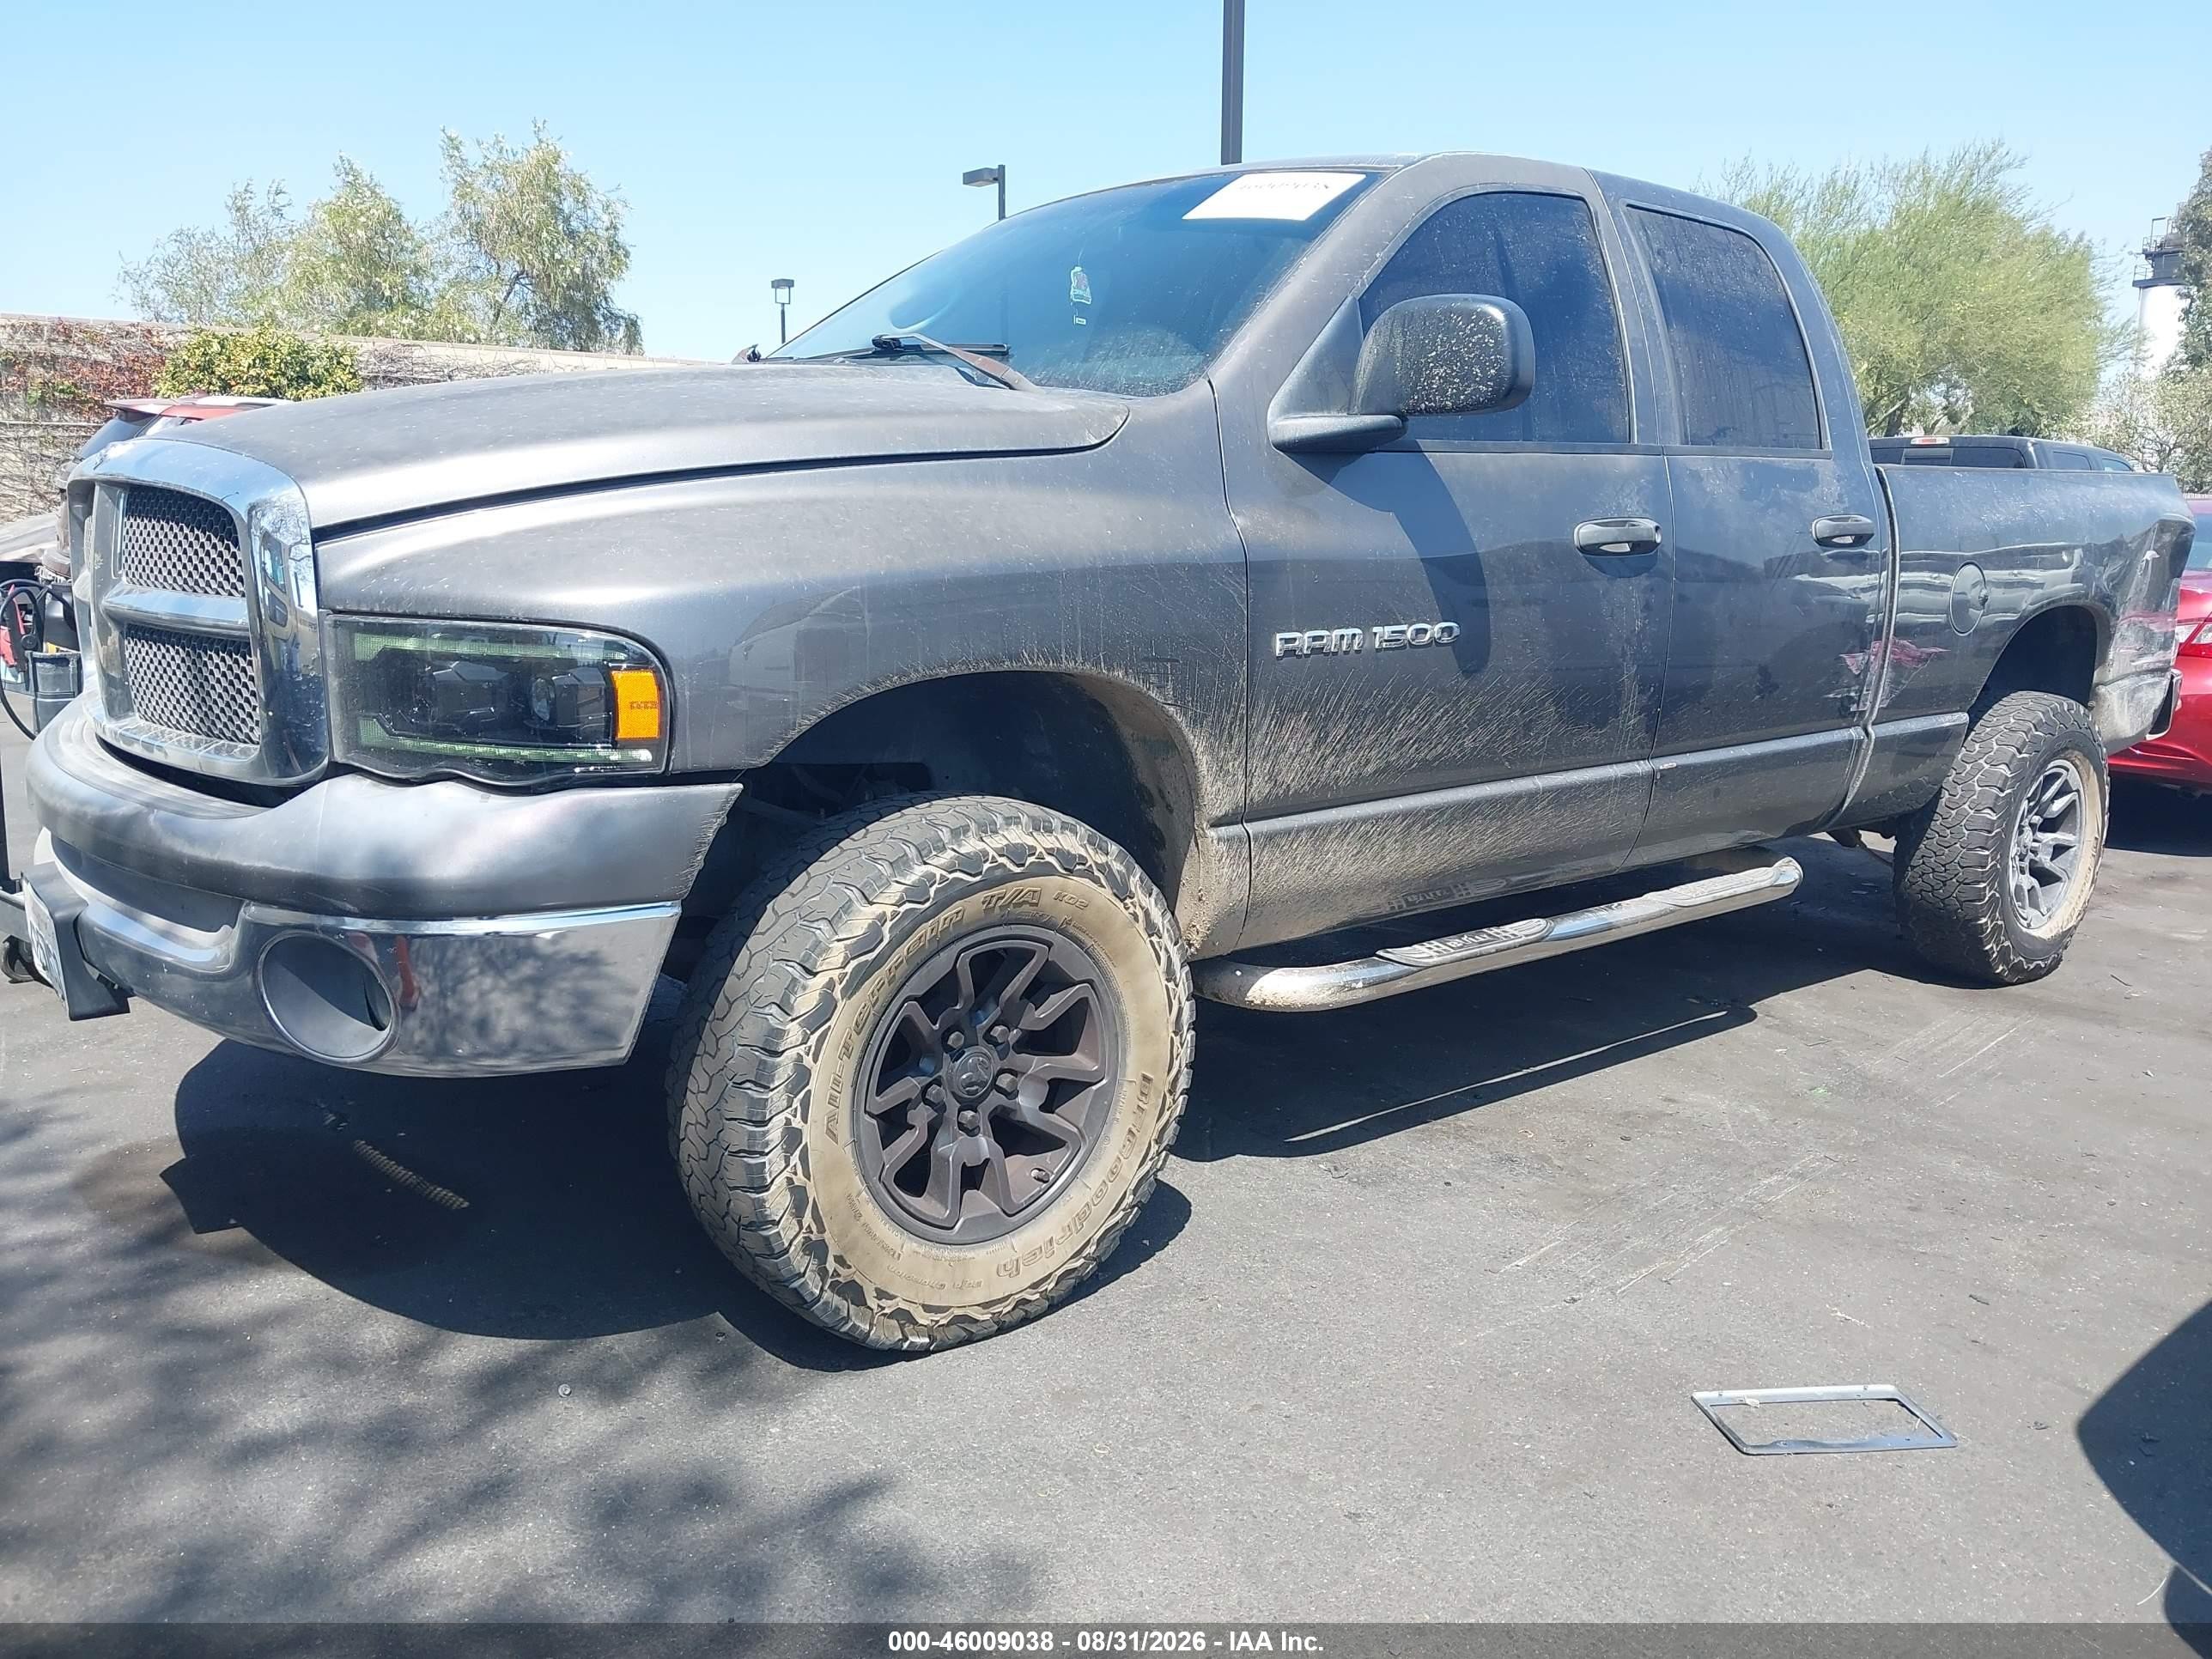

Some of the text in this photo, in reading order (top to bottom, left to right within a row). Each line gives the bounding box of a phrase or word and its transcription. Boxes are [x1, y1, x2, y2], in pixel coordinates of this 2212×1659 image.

[1275, 622, 1461, 658] RAM 1500
[825, 887, 1089, 1146] All-Terrain T/A KO2
[996, 1072, 1154, 1278] BFGoodrich
